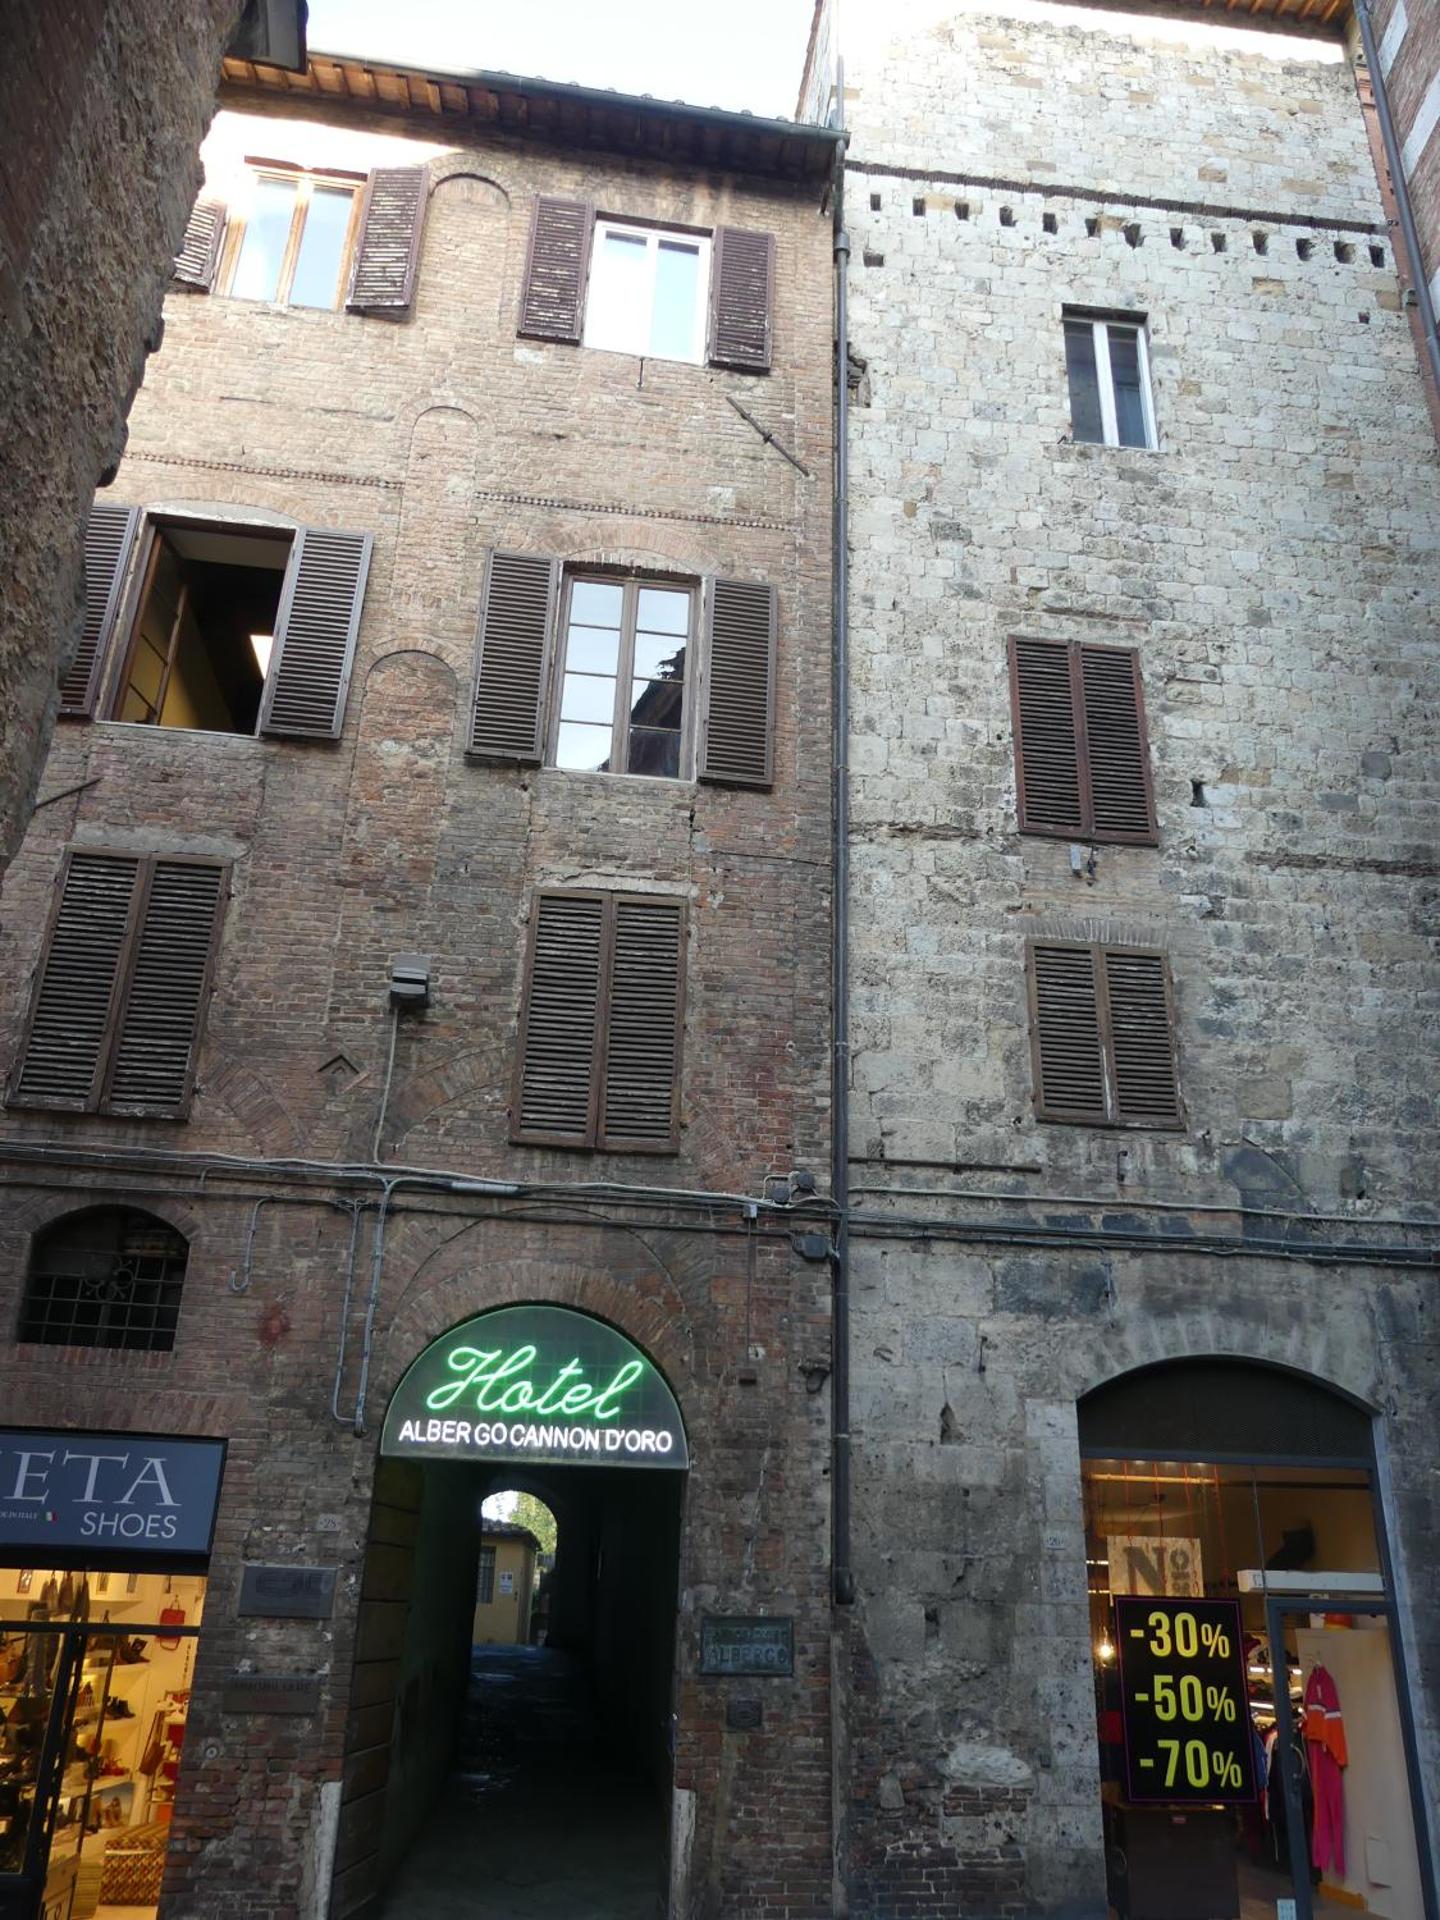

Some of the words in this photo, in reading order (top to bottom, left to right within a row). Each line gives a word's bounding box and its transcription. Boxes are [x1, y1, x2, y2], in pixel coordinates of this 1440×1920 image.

[427, 1345, 644, 1419] Hotel
[510, 1423, 601, 1450] CANNON
[605, 1428, 672, 1451] D'ORO
[80, 1511, 178, 1539] SHOES
[1130, 1611, 1230, 1659] -30%
[1135, 1674, 1237, 1722] -50%
[1140, 1739, 1243, 1788] -70%
